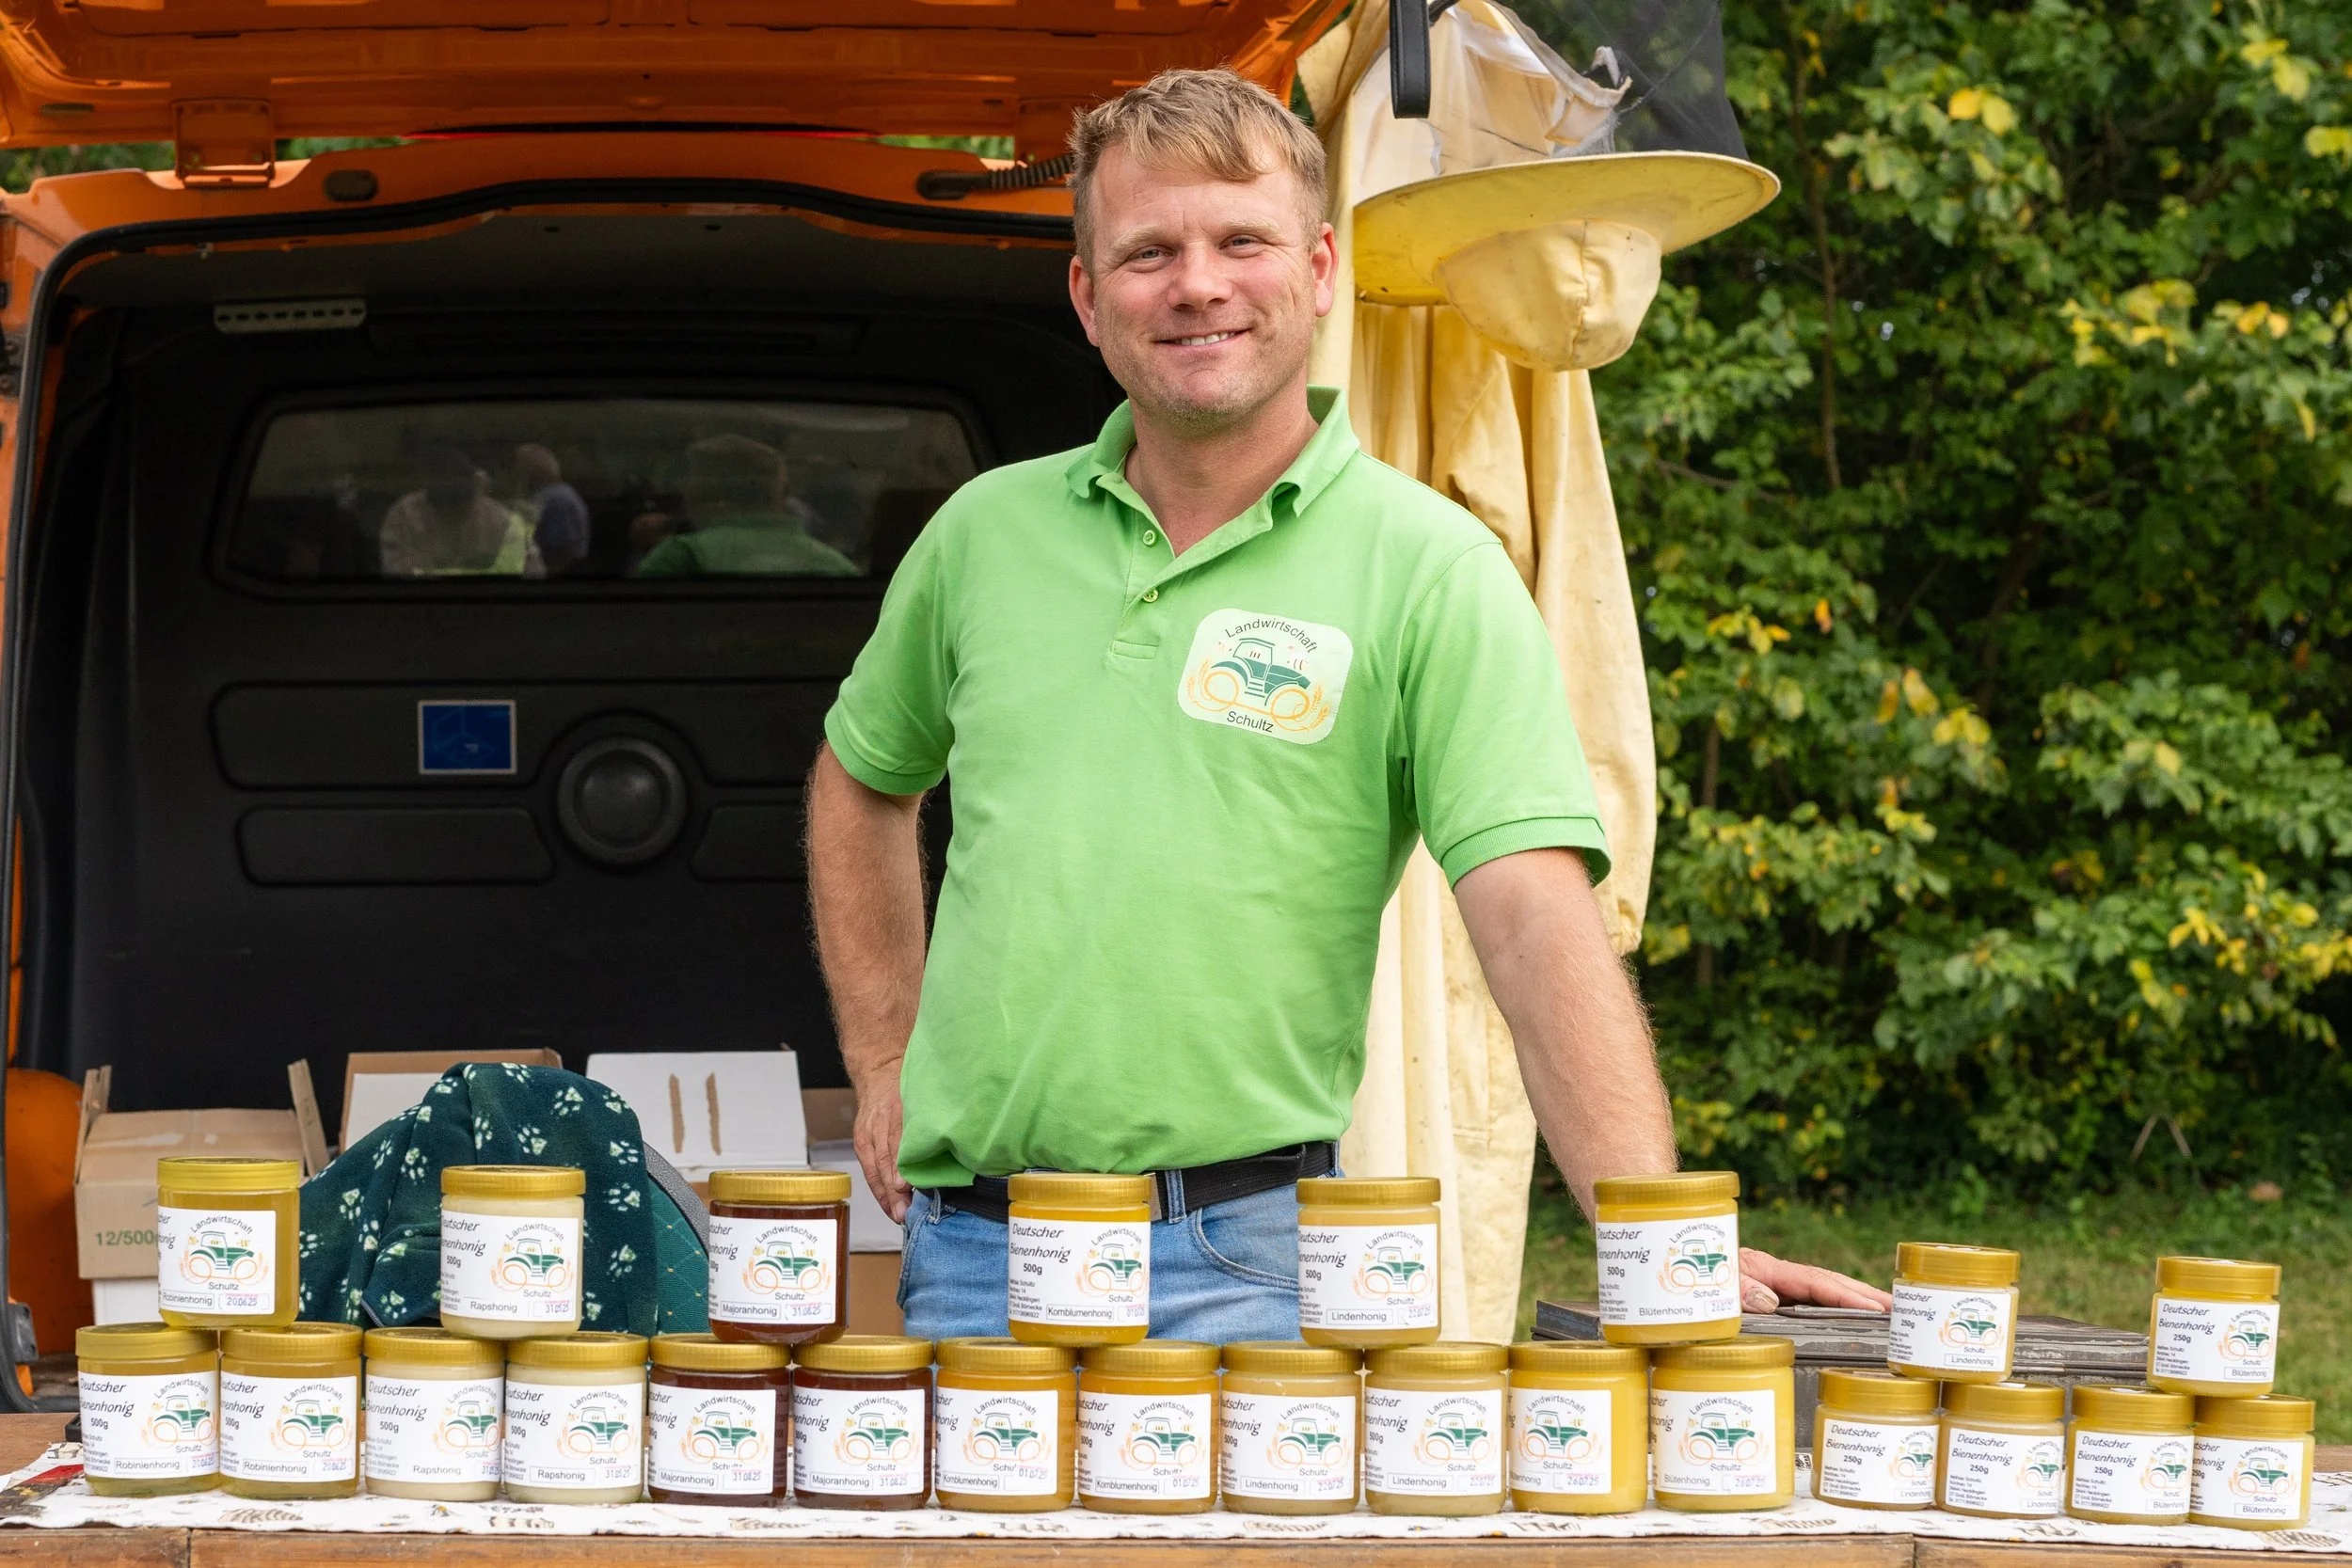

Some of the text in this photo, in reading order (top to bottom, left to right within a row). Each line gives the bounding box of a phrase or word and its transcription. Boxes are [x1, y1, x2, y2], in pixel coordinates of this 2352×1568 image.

[1225, 619, 1317, 653] Landwirtschaft
[1227, 711, 1274, 732] Schultz
[191, 1215, 252, 1234] Landwirtschaft
[506, 1223, 564, 1241] Landwirtschaft
[755, 1225, 818, 1243] Landwirtschaft
[1012, 1224, 1064, 1239] Deutscher
[96, 1230, 159, 1246] 12/500
[1365, 1230, 1423, 1249] Landwirtschaft
[1010, 1243, 1071, 1263] Bienenhonig
[447, 1255, 461, 1268] 500g
[1024, 1263, 1042, 1275] 500g
[1306, 1270, 1321, 1280] 500g
[1607, 1267, 1625, 1277] 500g
[208, 1282, 239, 1291] Schultz
[163, 1292, 213, 1306] Robinienhonig
[1693, 1290, 1720, 1298] Schultz
[470, 1301, 517, 1313] Rapshonig
[723, 1305, 777, 1316] Majoranhonig
[1639, 1307, 1692, 1316] Blütenhonig
[2163, 1304, 2210, 1316] Deutscher
[1048, 1308, 1112, 1319] Kornblumenhonig
[1332, 1312, 1387, 1322] Lindenhonig
[1901, 1320, 1915, 1329] 250g
[2159, 1319, 2215, 1335] Bienenhonig
[2173, 1334, 2191, 1343] 250g
[1952, 1356, 1994, 1365] Lindenhonig
[154, 1379, 209, 1398] Landwirtschaft
[284, 1384, 342, 1402] Landwirtschaft
[369, 1382, 420, 1397] Deutscher
[570, 1391, 628, 1409] Landwirtschaft
[694, 1396, 756, 1414] Landwirtschaft
[848, 1397, 907, 1415] Landwirtschaft
[975, 1396, 1037, 1415] Landwirtschaft
[1427, 1396, 1486, 1415] Landwirtschaft
[1527, 1395, 1586, 1415] Landwirtschaft
[1690, 1397, 1753, 1415] Landwirtschaft
[1134, 1401, 1194, 1418] Landwirtschaft
[1280, 1402, 1340, 1419] Landwirtschaft
[91, 1418, 108, 1429] 500g
[380, 1421, 399, 1433] 500g
[511, 1425, 526, 1437] 500g
[1832, 1425, 1881, 1438] Deutscher
[1224, 1434, 1237, 1447] 500g
[1370, 1432, 1383, 1443] 500g
[1958, 1434, 2008, 1447] Deutscher
[2082, 1436, 2132, 1449] Deutscher
[176, 1445, 202, 1453] Schultz
[1826, 1439, 1885, 1457] Bienenhonig
[2240, 1447, 2289, 1460] Landwirtschaft
[465, 1450, 488, 1459] Schultz
[1844, 1455, 1862, 1465] 250g
[1952, 1449, 2012, 1465] Bienenhonig
[2078, 1450, 2137, 1467] Bienenhonig
[116, 1461, 181, 1469] Robinienhonig
[244, 1462, 307, 1474] Robinienhonig
[413, 1465, 461, 1475] Rapshonig
[1970, 1465, 1988, 1474] 250g
[2094, 1466, 2112, 1476] 250g
[538, 1470, 585, 1481] Rapshonig
[660, 1472, 714, 1486] Majoranhonig
[813, 1476, 869, 1487] Majoranhonig
[944, 1476, 997, 1487] Kornblumenhonig
[1664, 1474, 1709, 1485] Blütenhonig
[1096, 1481, 1157, 1492] Kornblumenhonig
[1246, 1480, 1298, 1492] Lindenhonig
[1393, 1477, 1447, 1488] Lindenhonig
[2243, 1506, 2286, 1514] Blütenhonig
